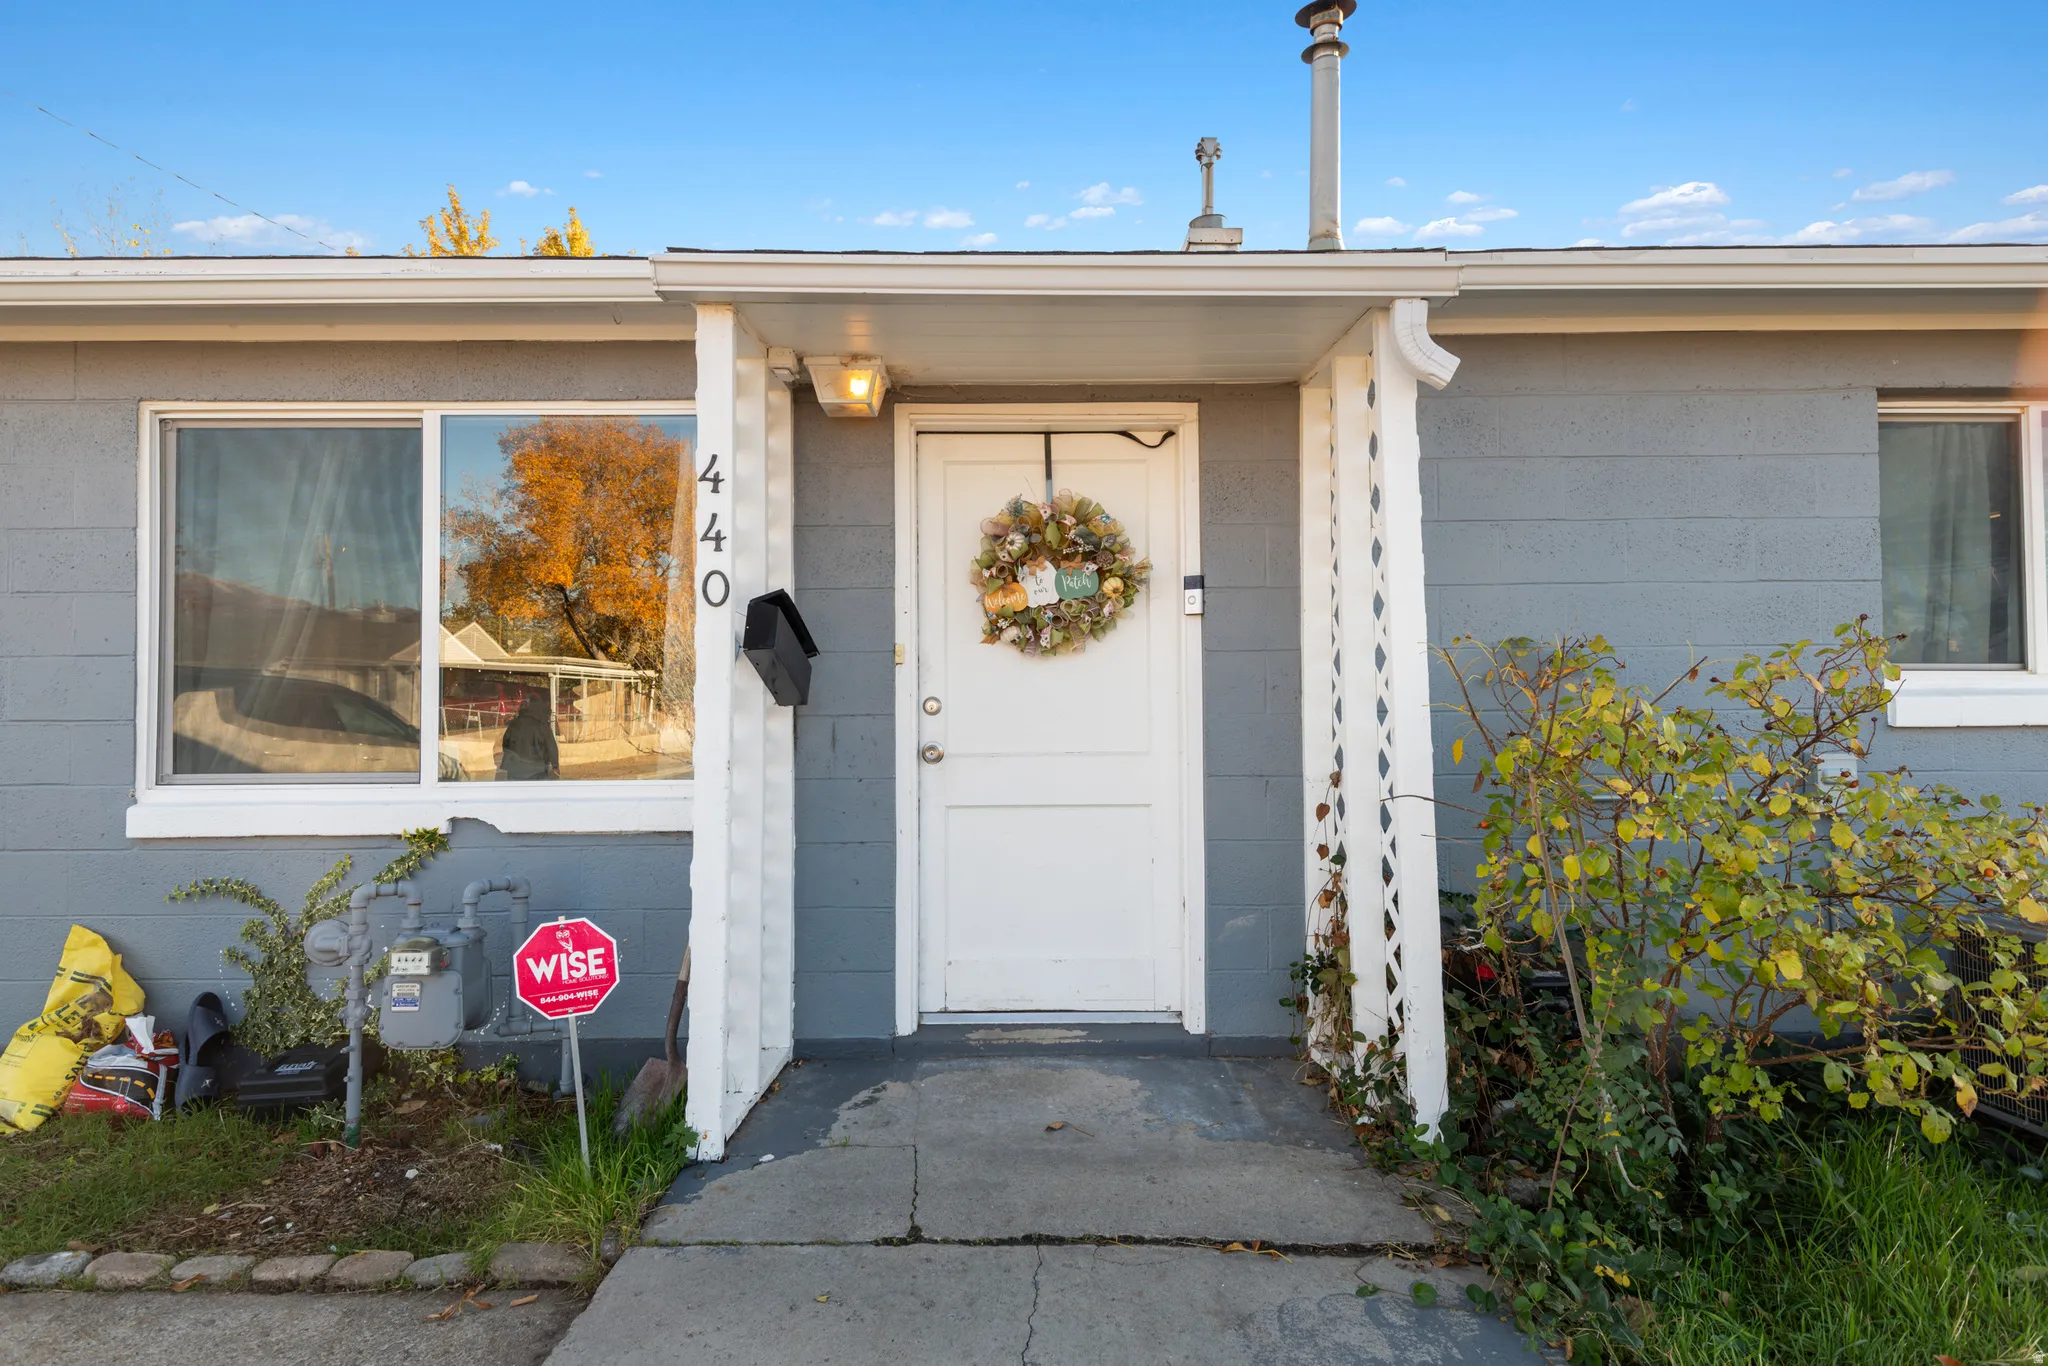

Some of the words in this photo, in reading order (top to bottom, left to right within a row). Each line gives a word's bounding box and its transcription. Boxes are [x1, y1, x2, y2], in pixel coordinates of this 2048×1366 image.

[698, 454, 730, 607] 440
[1061, 573, 1092, 591] Patch
[984, 591, 1027, 608] Welcome
[525, 947, 607, 984] WISE
[540, 988, 599, 1004] 844-904-WISE
